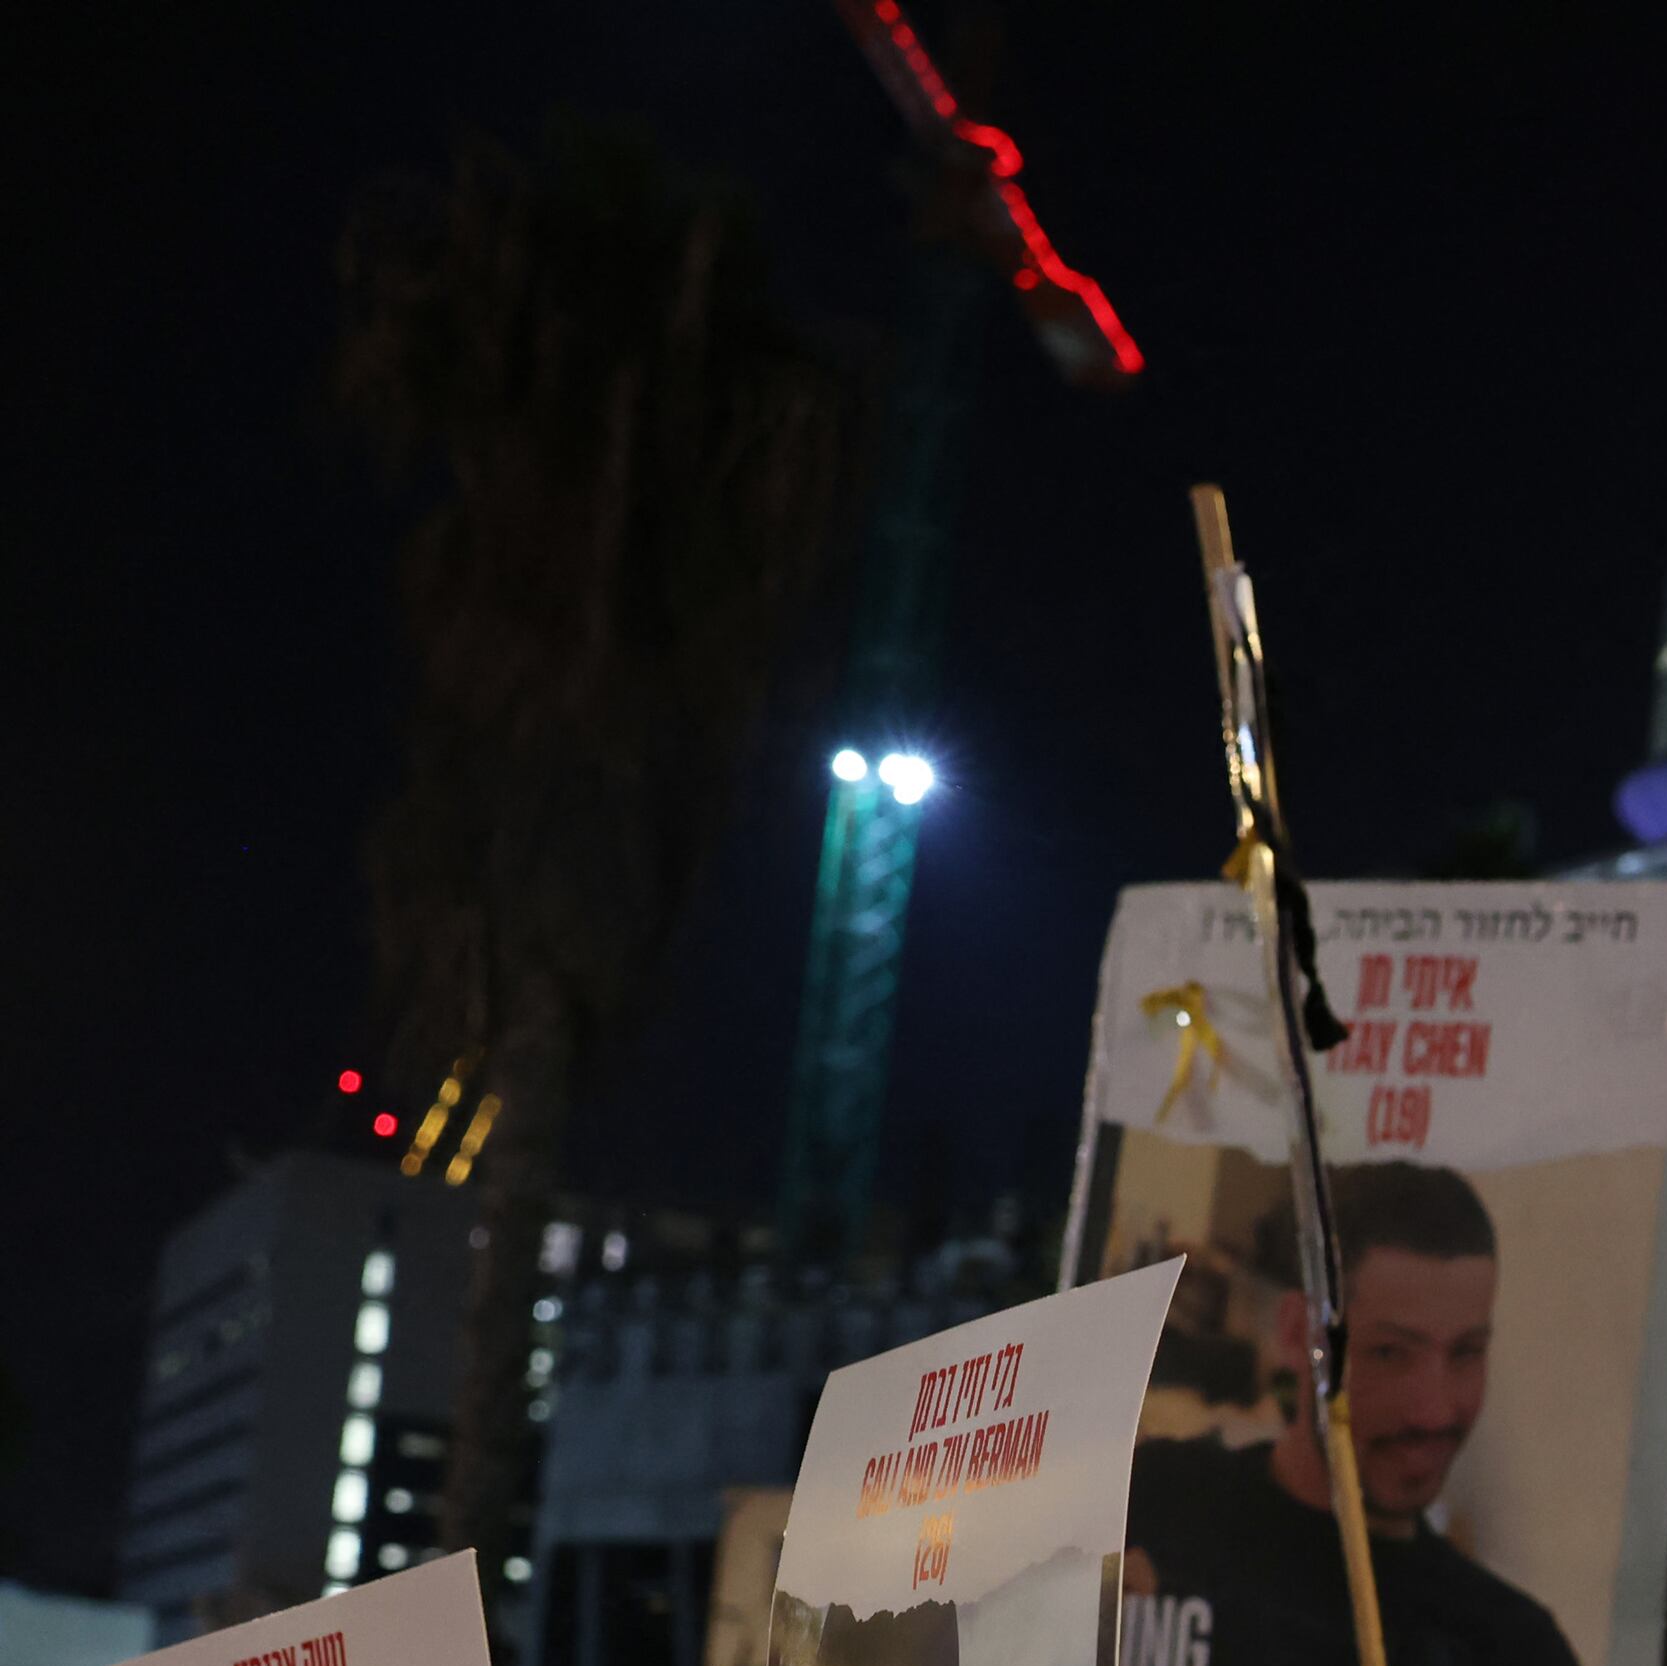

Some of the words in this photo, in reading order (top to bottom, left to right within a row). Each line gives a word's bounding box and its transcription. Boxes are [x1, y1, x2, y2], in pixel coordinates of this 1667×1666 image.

[1403, 1019, 1492, 1079] CHEN
[1366, 1083, 1433, 1150] (19)
[897, 1441, 938, 1508] AND
[963, 1409, 1050, 1495] BERMAN
